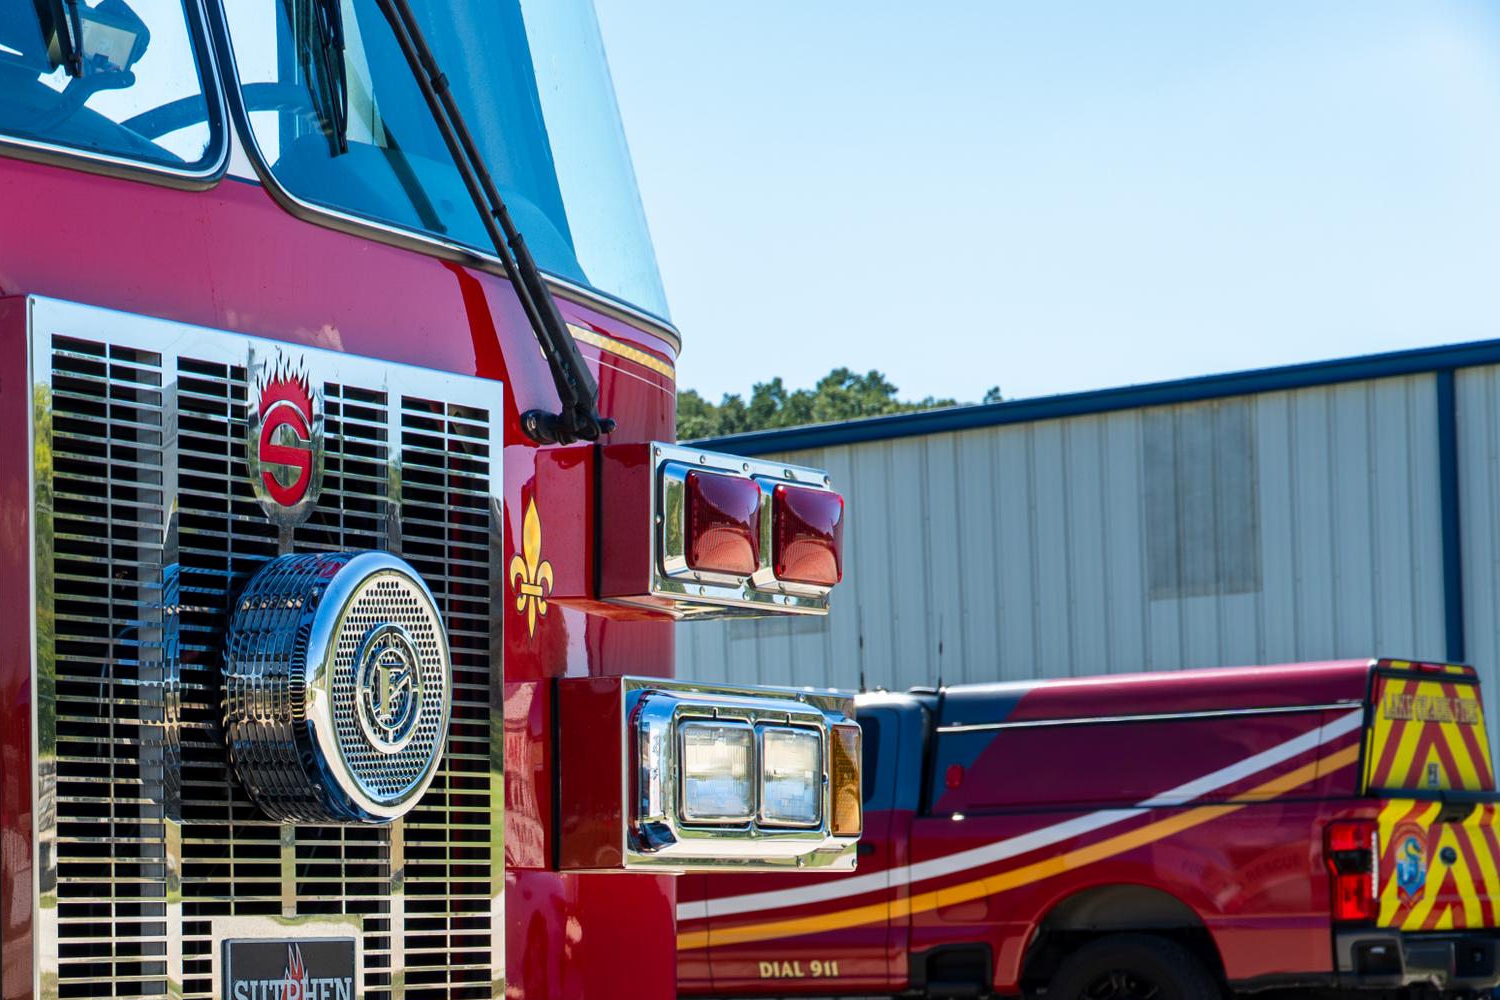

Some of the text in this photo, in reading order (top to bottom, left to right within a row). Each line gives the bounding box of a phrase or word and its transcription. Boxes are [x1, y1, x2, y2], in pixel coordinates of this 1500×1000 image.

[1383, 692, 1412, 720] LAKE
[758, 959, 839, 978] DIAL 911
